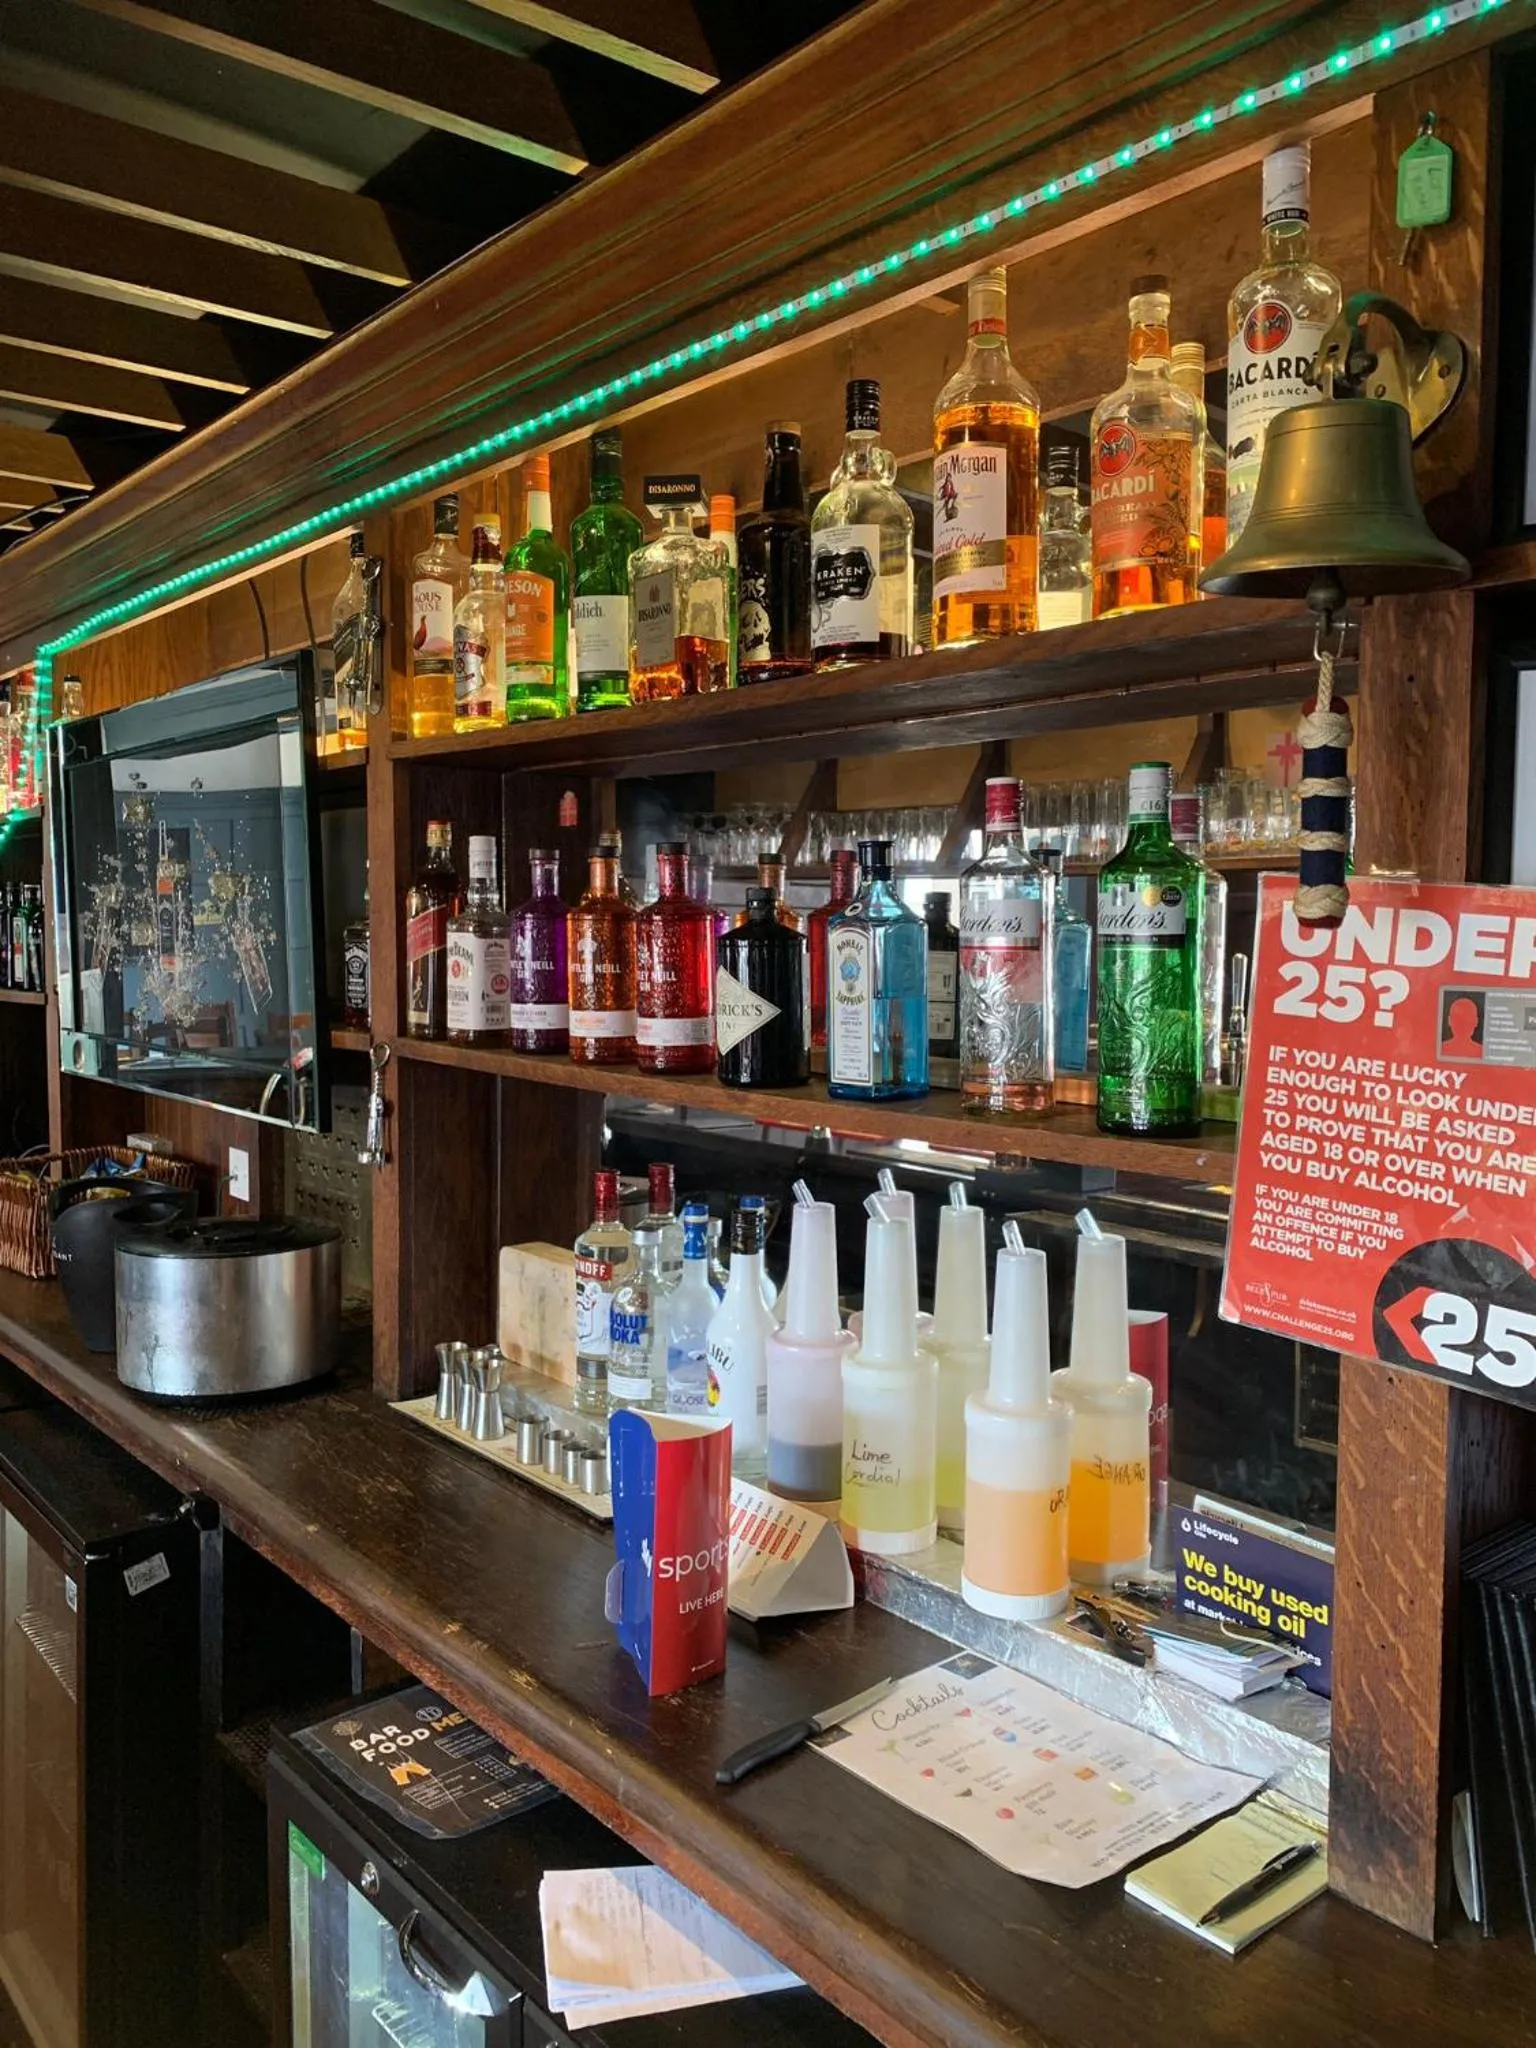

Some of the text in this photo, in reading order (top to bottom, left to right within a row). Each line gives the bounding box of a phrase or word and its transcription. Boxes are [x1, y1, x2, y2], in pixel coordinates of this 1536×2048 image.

[1263, 387, 1309, 398] BLANCA
[950, 454, 997, 476] Morgan
[648, 483, 696, 495] DISARONNO
[505, 579, 543, 597] ESON
[817, 566, 864, 582] KRAKEN
[837, 938, 865, 955] BOMBAY
[595, 963, 622, 974] NEILL
[718, 1003, 763, 1017] RICK'S
[1273, 960, 1410, 1028] 25?
[1268, 1045, 1468, 1089] IF YOU ARE LUCKY
[1267, 1066, 1356, 1096] ENOUGH
[1362, 1081, 1391, 1101] TO
[1396, 1086, 1460, 1113] LOOK
[1264, 1088, 1516, 1146] 25 YOU WILL BE ASKED
[1262, 1109, 1536, 1175] TO PROVE THAT YOU ARE
[1260, 1130, 1526, 1197] AGED 18 OR OVER WHEN
[1260, 1151, 1460, 1208] YOU BUY ALCOHOL
[1254, 1197, 1405, 1240] YOU ARE COMMITTING
[1255, 1183, 1398, 1225] IF YOU ARE UNDER 18
[1250, 1236, 1314, 1261] ALCOHOL
[1251, 1223, 1367, 1260] ATTEMPT TO BUY
[1252, 1210, 1387, 1251] AN OFFENCE IF YOU
[576, 1259, 607, 1277] NOFF
[1243, 1303, 1356, 1342] WWW.CHALLENGE25.ORG
[1421, 1291, 1536, 1388] 25
[852, 1439, 892, 1464] Lime
[1193, 1520, 1239, 1545] Lifecycle
[1183, 1548, 1329, 1625] We buy used
[1183, 1598, 1195, 1611] at
[679, 1598, 703, 1615] LIVE
[1184, 1575, 1306, 1639] cooking oil
[349, 1725, 402, 1751] BAR
[361, 1728, 431, 1762] FOOD
[430, 1711, 468, 1732] ME
